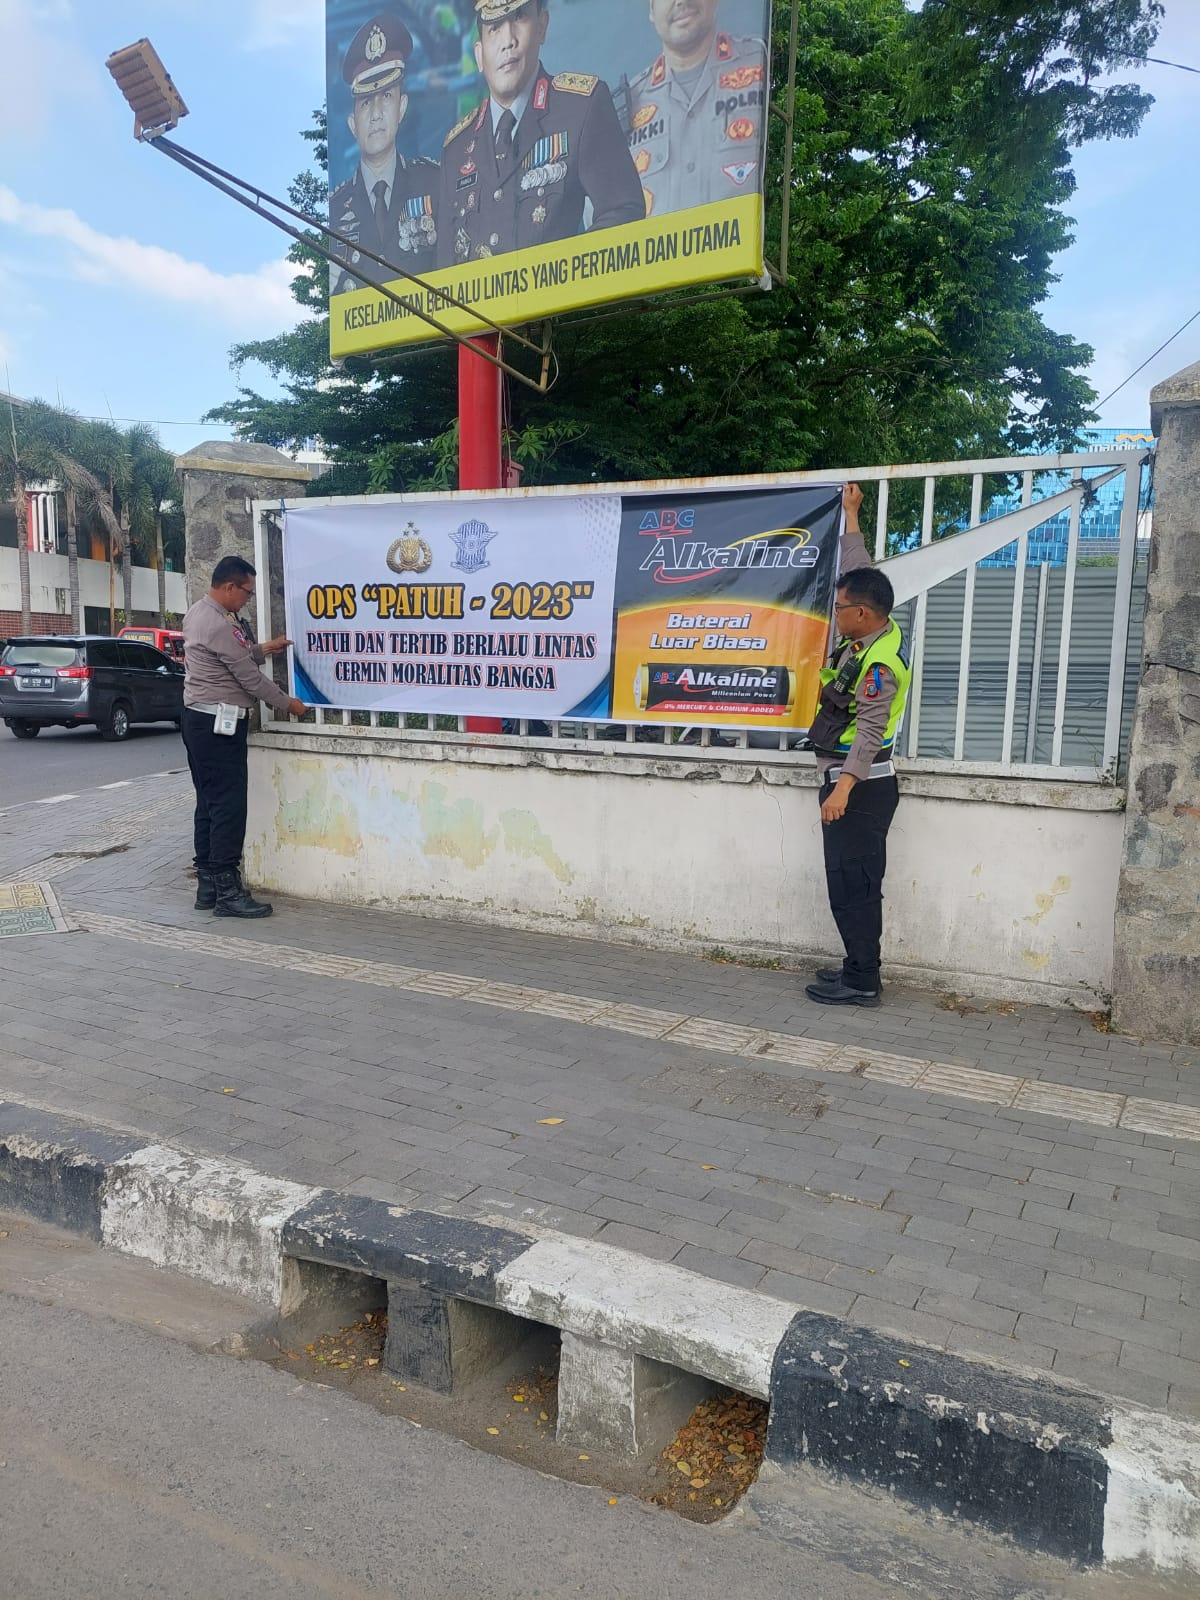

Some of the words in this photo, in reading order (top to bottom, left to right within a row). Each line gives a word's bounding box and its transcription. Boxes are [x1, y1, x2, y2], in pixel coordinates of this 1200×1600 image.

[715, 91, 763, 116] POLRI
[484, 267, 528, 300] LINTAS
[532, 258, 568, 289] YANG
[571, 241, 640, 281] PERTAMA
[645, 232, 677, 264] DAN
[682, 218, 740, 257] UTAMA
[639, 509, 695, 530] ABC
[639, 537, 820, 571] Alkaline
[307, 584, 356, 620] OPS
[666, 613, 751, 629] Baterai
[307, 632, 350, 655] PATUH
[355, 632, 385, 655] DAN
[390, 633, 448, 655] TERTIB
[453, 634, 528, 657] BERLALU
[533, 635, 596, 658] LINTAS
[649, 634, 699, 650] Luar
[702, 634, 767, 651] Biasa
[335, 662, 387, 684] CERMIN
[391, 663, 481, 687] MORALITAS
[486, 666, 555, 689] BANGSA
[654, 671, 675, 681] ABC
[675, 668, 777, 688] Alkaline
[677, 703, 707, 711] MERCURY
[716, 704, 749, 713] CADMIUM
[751, 706, 775, 714] ADDED
